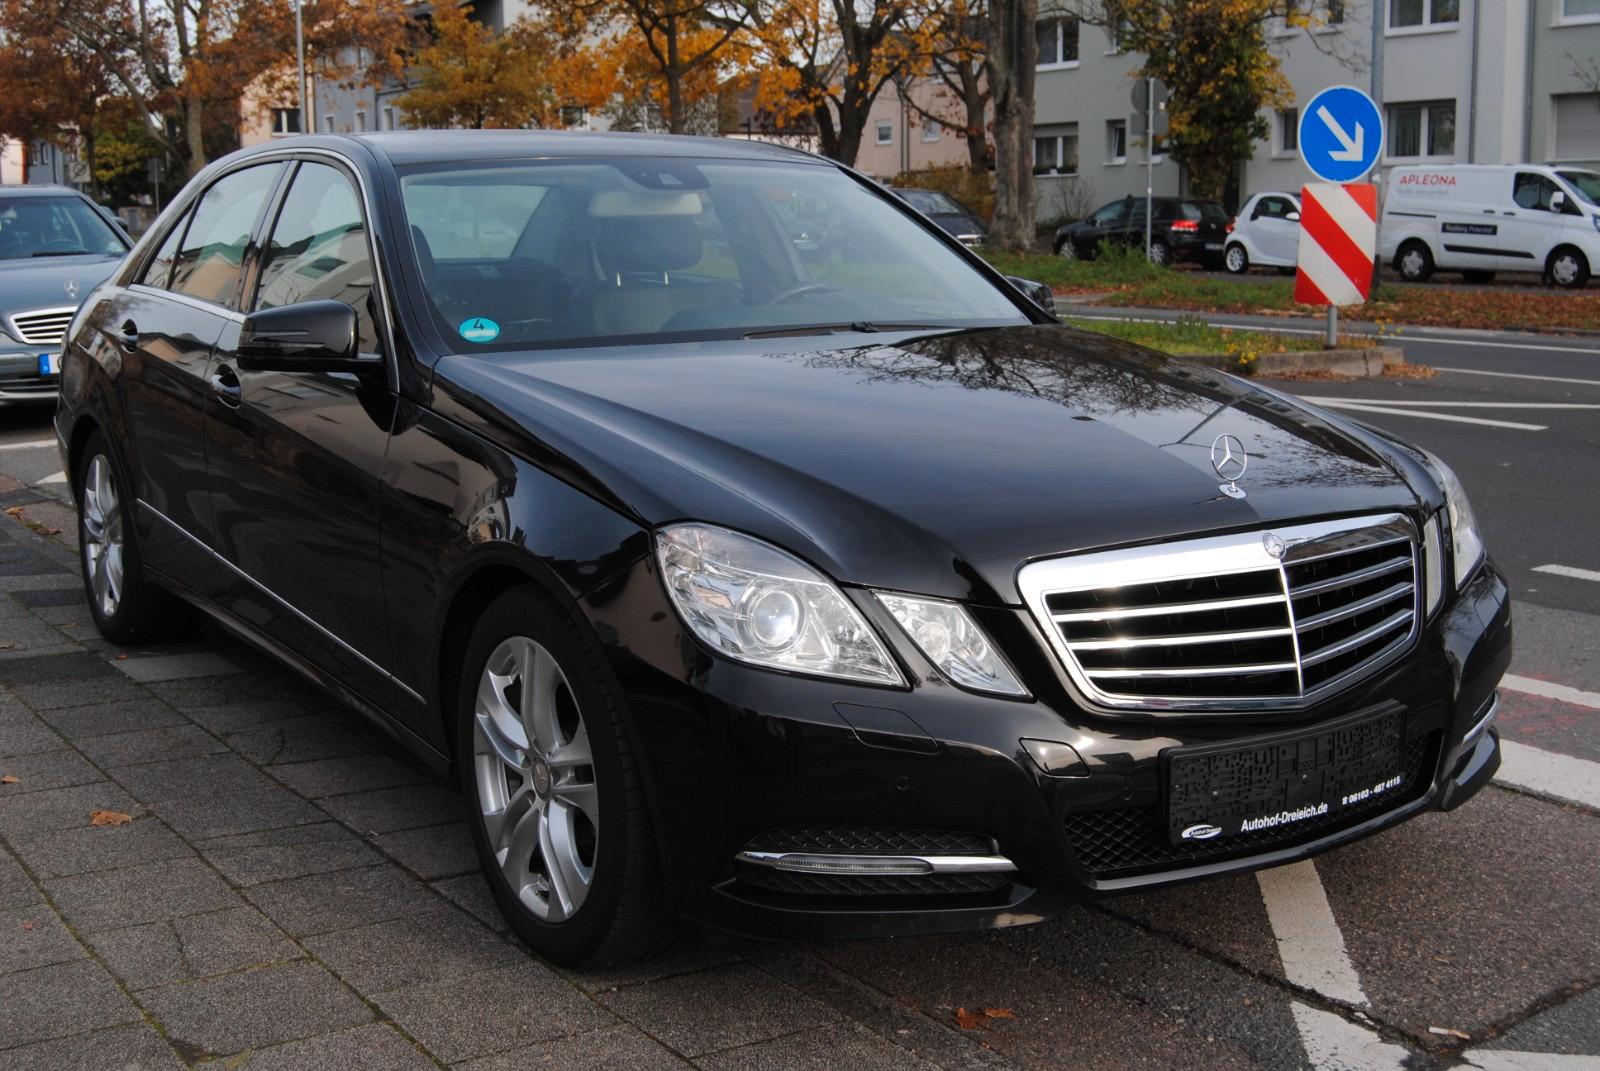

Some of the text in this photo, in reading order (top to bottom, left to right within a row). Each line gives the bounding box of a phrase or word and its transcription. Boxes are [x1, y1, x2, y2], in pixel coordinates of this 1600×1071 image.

[1400, 174, 1457, 186] APLEONA
[473, 318, 485, 330] 4
[1241, 802, 1328, 832] Autohof-Dreieich.de
